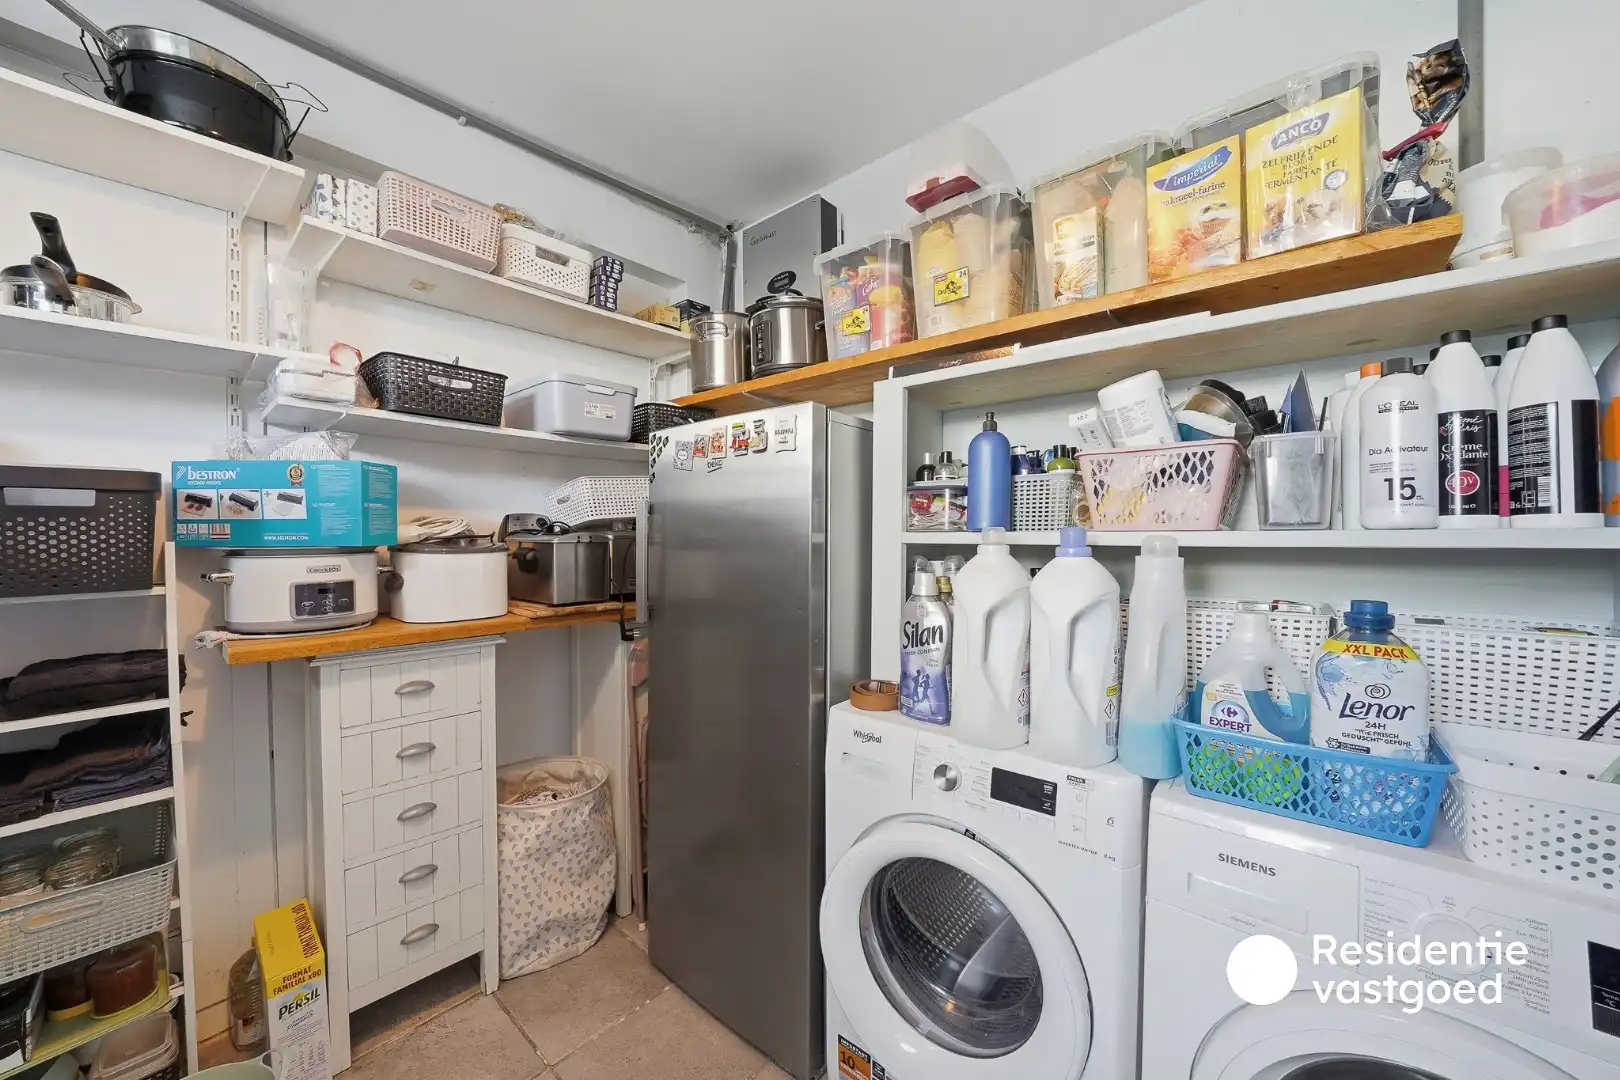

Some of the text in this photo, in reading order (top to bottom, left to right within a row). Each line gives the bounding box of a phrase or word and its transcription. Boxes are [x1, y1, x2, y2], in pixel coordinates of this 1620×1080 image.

[1276, 119, 1322, 147] ANCO
[1173, 154, 1219, 186] imperial
[1369, 448, 1382, 456] Dia
[1384, 477, 1416, 501] 15
[903, 620, 944, 649] Silan
[1342, 643, 1409, 659] XXL PACK
[1339, 692, 1415, 721] Lenor
[1210, 716, 1252, 732] EXPERT
[1365, 721, 1386, 730] 24H
[853, 729, 881, 743] Whirlpool
[1373, 731, 1399, 739] FRISCH
[1218, 852, 1276, 877] SIEMENS
[282, 965, 312, 984] FORMAT
[272, 975, 305, 996] FAMILIAL
[279, 987, 320, 1021] PERSIL
